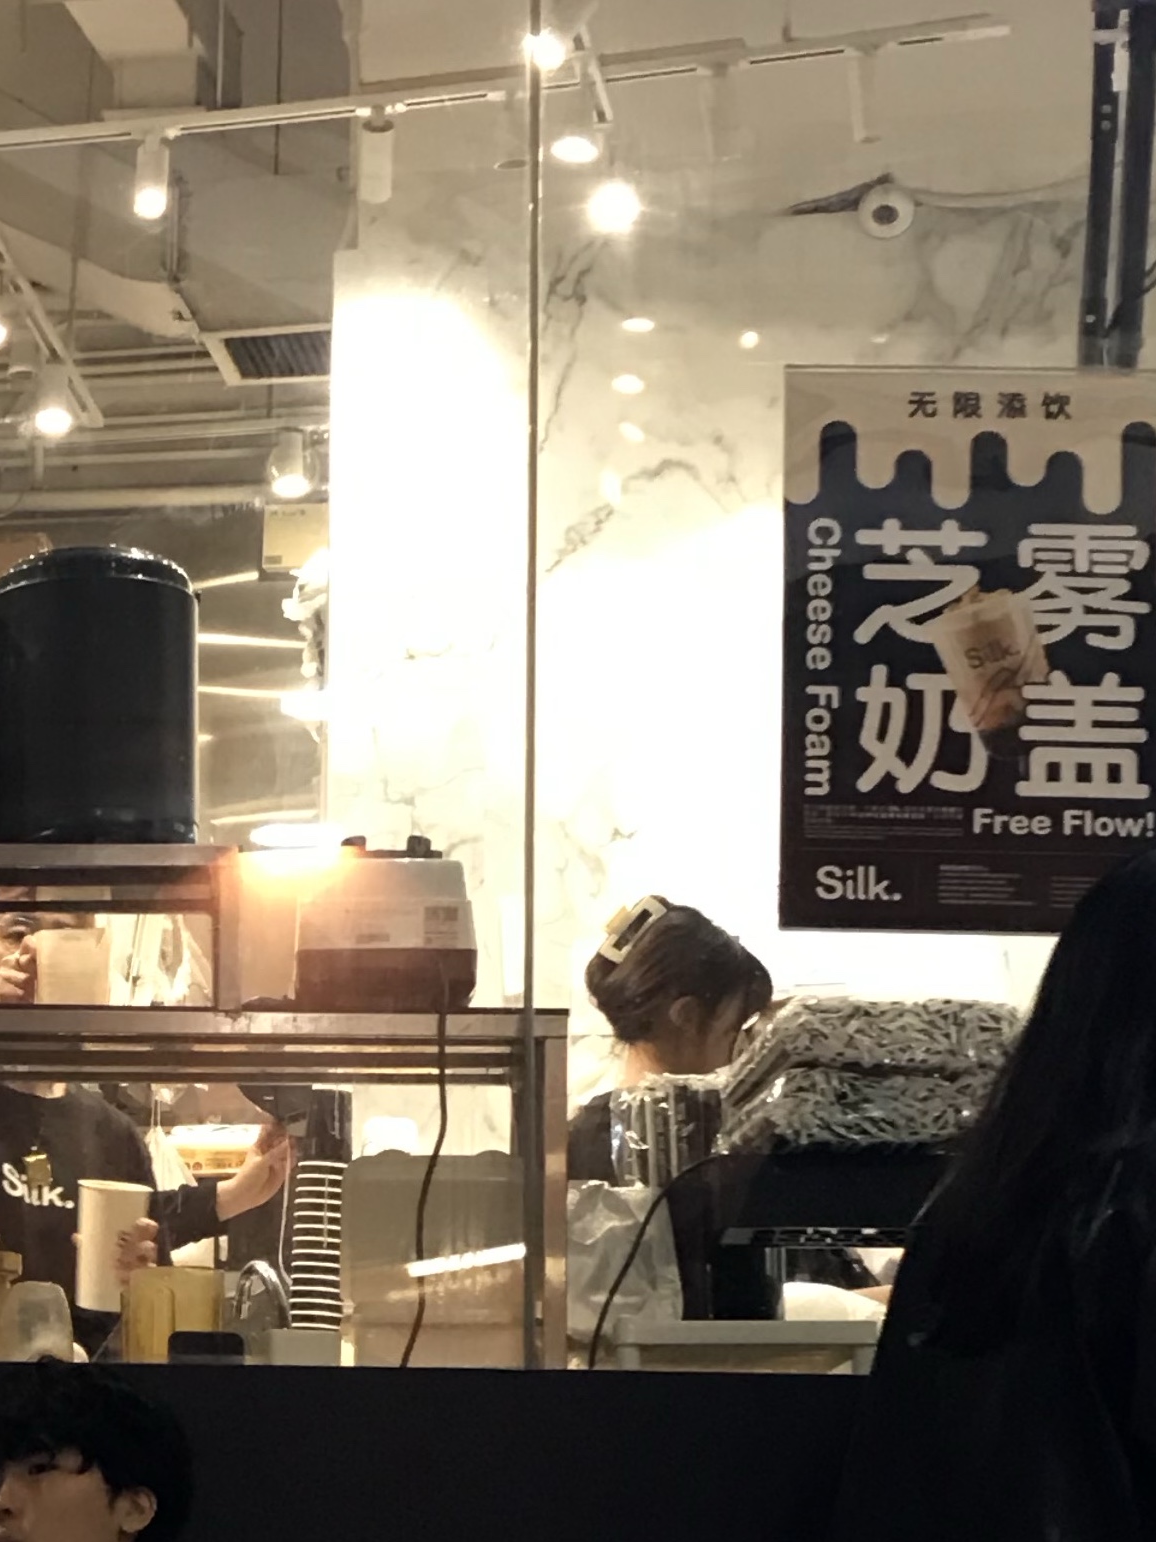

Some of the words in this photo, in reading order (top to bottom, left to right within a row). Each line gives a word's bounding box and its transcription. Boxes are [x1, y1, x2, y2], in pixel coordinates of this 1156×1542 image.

[907, 391, 1073, 421] 无限添饮
[805, 517, 842, 671] Cheese
[853, 518, 1152, 650] 芝雾
[803, 685, 841, 797] Foam
[855, 664, 1152, 800] 奶盖
[972, 807, 1053, 835] Free
[1061, 809, 1156, 838] Flow!
[814, 865, 903, 901] Silk.
